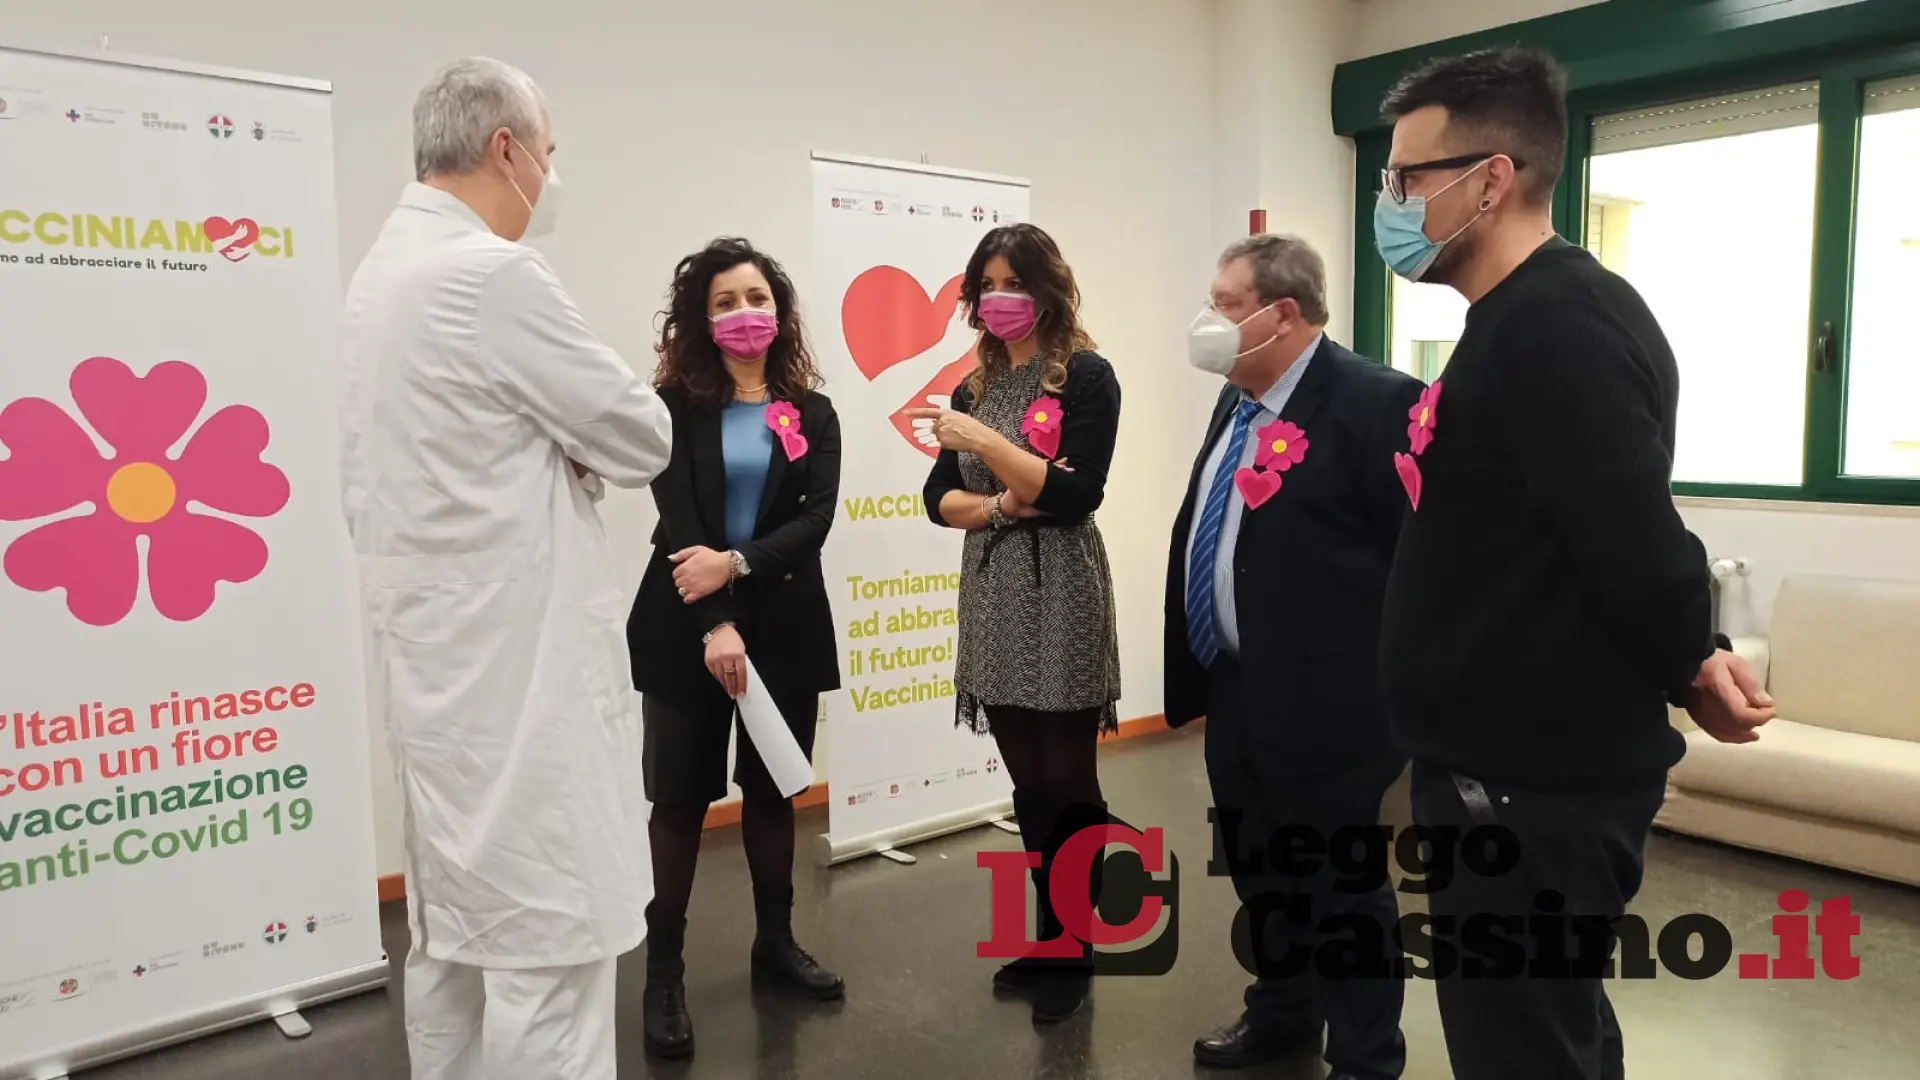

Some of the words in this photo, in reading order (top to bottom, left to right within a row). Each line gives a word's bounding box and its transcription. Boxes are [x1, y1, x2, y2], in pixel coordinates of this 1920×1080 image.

[25, 252, 44, 265] ad
[50, 253, 142, 270] abbracciare
[146, 258, 156, 271] il
[162, 259, 208, 273] futuro
[844, 493, 925, 522] VACCI
[846, 569, 960, 601] Torniamo
[848, 610, 879, 639] ad
[886, 605, 960, 634] abbra
[850, 649, 862, 677] il
[869, 637, 953, 674] futuro!
[149, 682, 315, 729] rinasce
[850, 673, 957, 713] Vaccinia
[99, 744, 158, 779] un
[171, 726, 278, 766] fiore
[0, 764, 308, 843] vaccinazione
[0, 808, 249, 892] anti-Covid
[262, 797, 313, 836] 19
